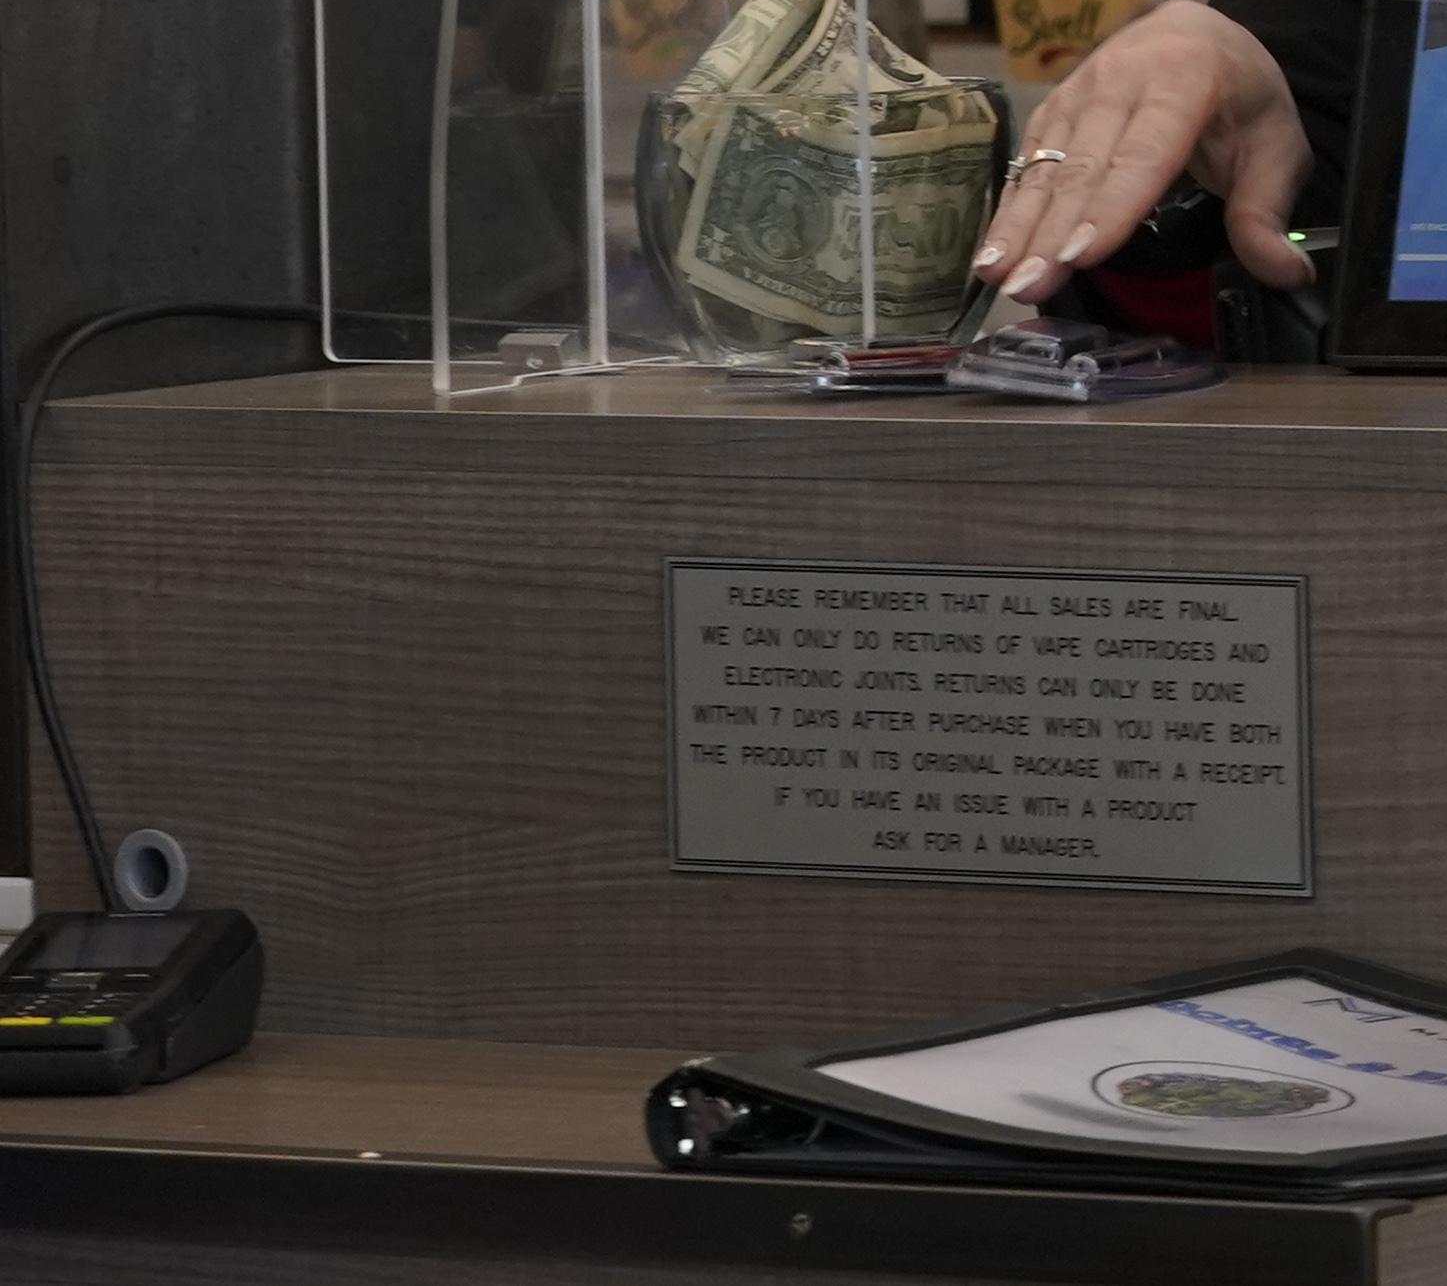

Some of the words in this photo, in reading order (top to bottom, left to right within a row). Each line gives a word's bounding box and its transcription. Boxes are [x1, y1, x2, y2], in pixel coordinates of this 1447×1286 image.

[729, 586, 802, 608] PLEASE
[815, 588, 929, 612] REMEMBER
[941, 592, 990, 614] THAT
[1002, 594, 1039, 616] ALL
[1050, 596, 1112, 618] SALES
[1125, 598, 1165, 620] ARE
[699, 625, 730, 647] WE
[744, 627, 781, 647] CAN
[794, 628, 842, 650] ONLY
[854, 630, 880, 650] DO
[892, 631, 985, 654] RETURNS
[996, 634, 1023, 655] OF
[1032, 635, 1081, 658] VAPE
[1094, 637, 1216, 662] CARTRIDGES
[1228, 642, 1271, 664] AND
[724, 665, 843, 689] ELECTRONIC
[933, 672, 1027, 696] RETURNS
[1038, 676, 1078, 698] CAN
[1089, 678, 1141, 700] ONLY
[1152, 680, 1179, 701] BE
[1191, 681, 1246, 704] DONE
[692, 704, 760, 726] WITHIN
[769, 706, 782, 727] 7
[793, 707, 840, 729] DAYS
[851, 709, 916, 732] AFTER
[928, 712, 1030, 736] PURCHASE
[1043, 716, 1102, 739] WHEN
[1114, 719, 1154, 741] YOU
[1164, 721, 1216, 743] HAVE
[1229, 723, 1282, 745] BOTH
[690, 743, 728, 765] THE
[741, 745, 827, 768] PRODUCT
[840, 748, 860, 769] IN
[871, 749, 900, 771] ITS
[912, 751, 1003, 775] ORIGINAL
[1013, 755, 1100, 779] PACKAGE
[1112, 759, 1161, 781] WITH
[1172, 761, 1190, 782] A
[774, 786, 792, 807] IF
[801, 787, 841, 809] YOU
[851, 789, 902, 811] HAVE
[914, 792, 942, 812] AN
[953, 793, 1009, 816] ISSUE
[1022, 796, 1070, 819] WITH
[1082, 797, 1097, 819] A
[1107, 799, 1198, 822] PRODUCT
[872, 830, 911, 852] ASK
[922, 831, 962, 853] FOR
[973, 833, 990, 854] A
